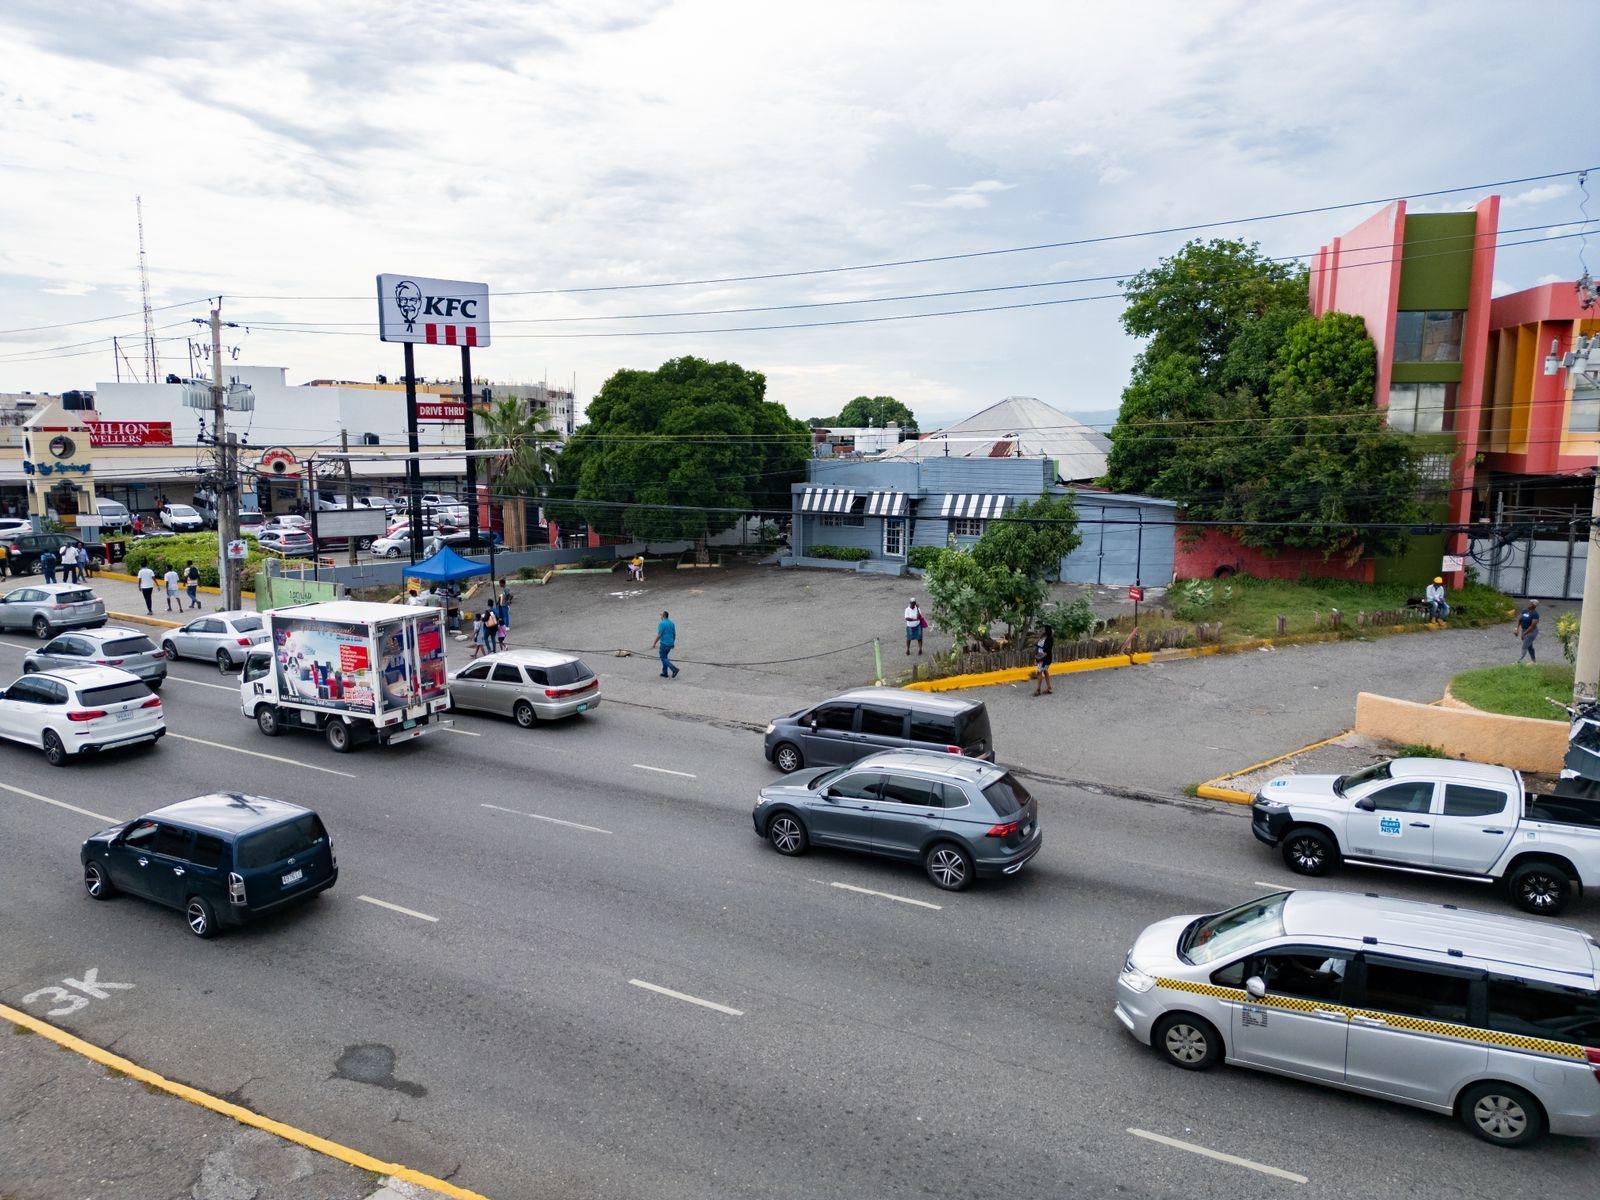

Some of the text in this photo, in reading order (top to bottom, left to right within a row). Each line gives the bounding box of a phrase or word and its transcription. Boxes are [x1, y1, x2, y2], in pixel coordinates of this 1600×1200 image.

[423, 296, 477, 318] KFC
[420, 406, 465, 416] DRIVE THRU
[70, 423, 150, 435] VILION
[90, 434, 142, 443] WELLERS
[22, 967, 136, 1016] 3K
